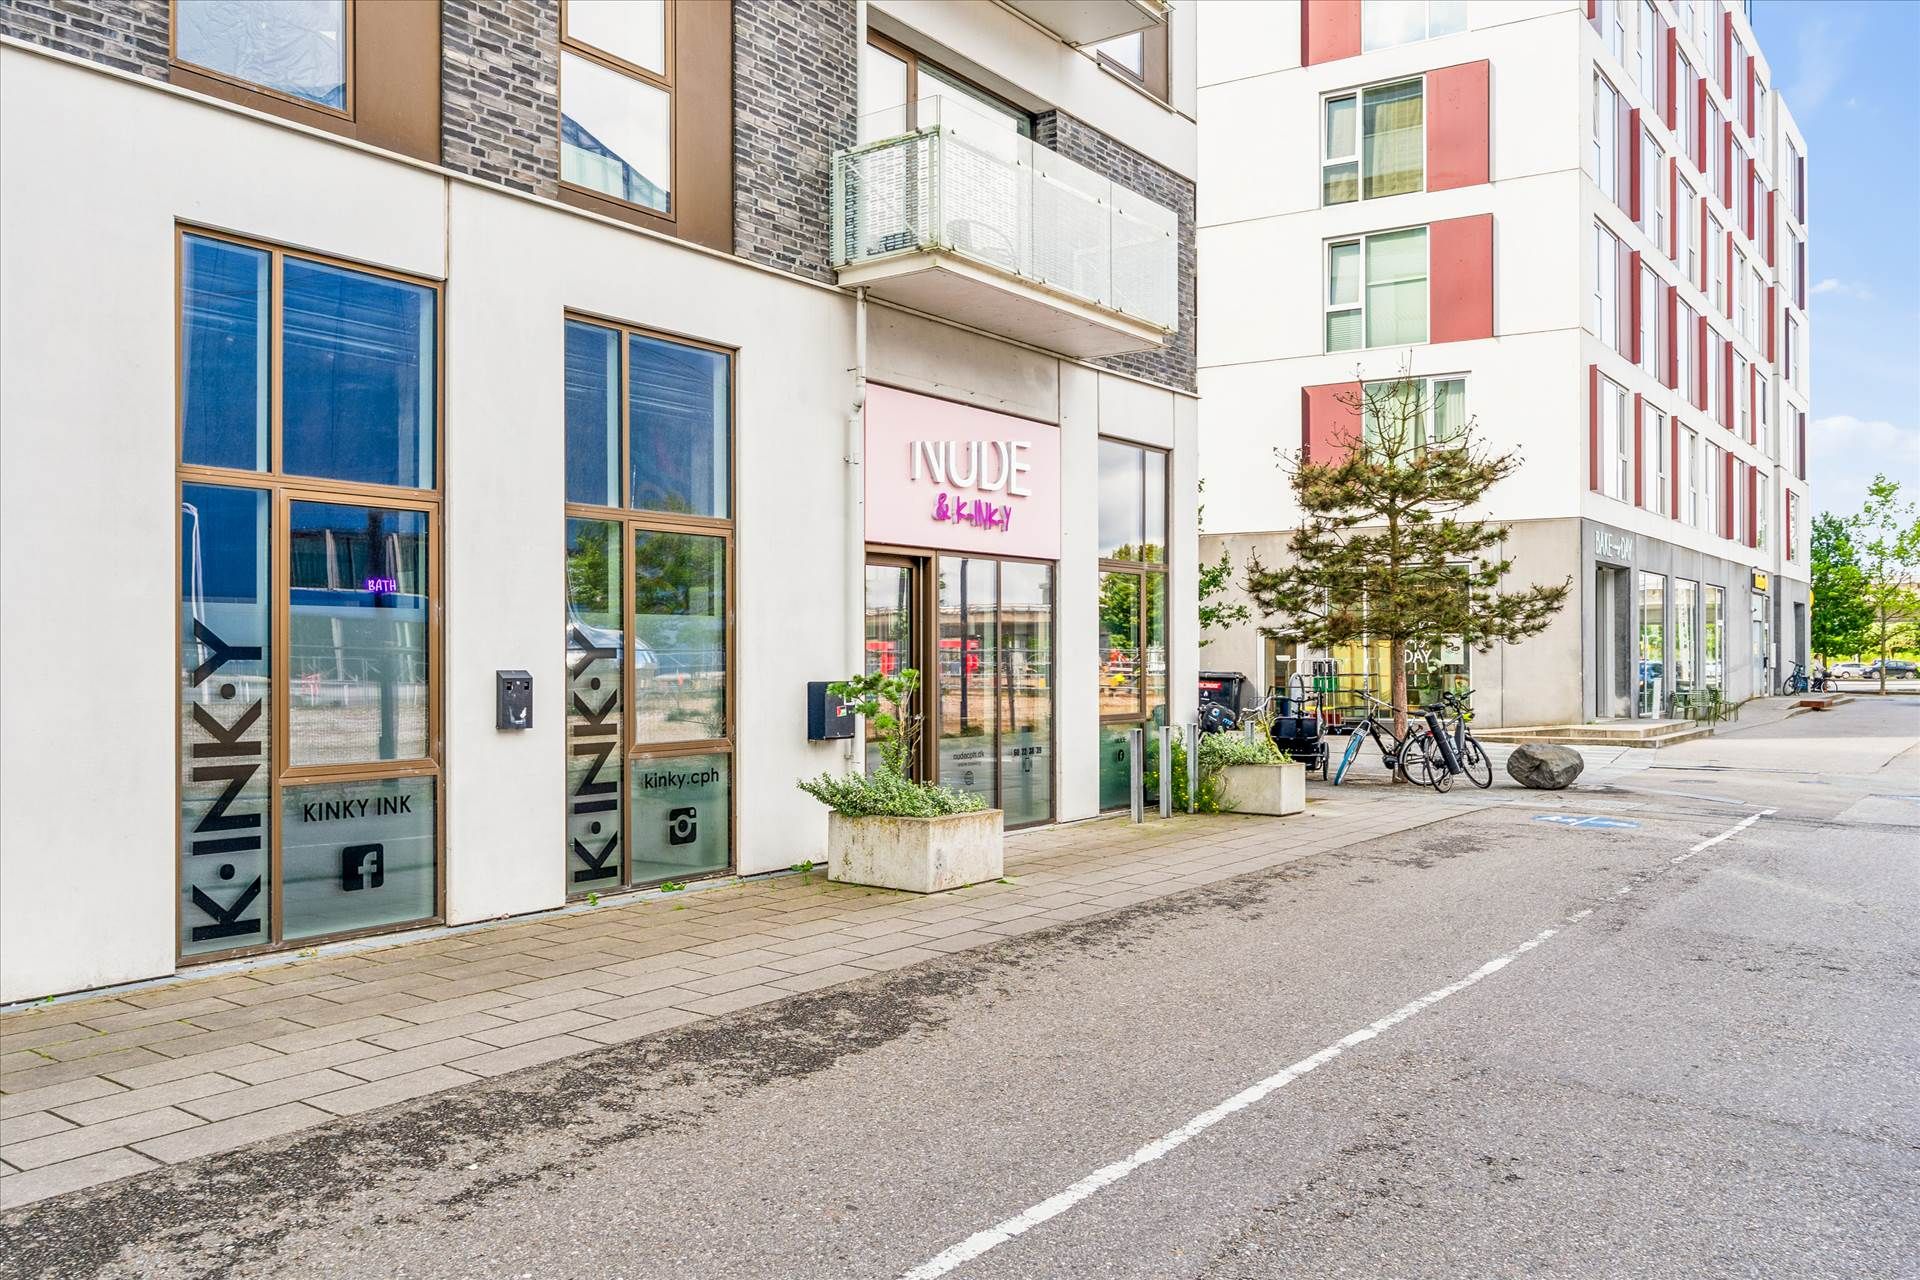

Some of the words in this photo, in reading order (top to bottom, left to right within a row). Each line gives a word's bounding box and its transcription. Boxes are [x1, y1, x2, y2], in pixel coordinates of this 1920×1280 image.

[910, 441, 1032, 497] NUDE
[934, 493, 950, 520] &
[368, 579, 397, 592] BATH
[1404, 649, 1432, 663] DAY
[644, 768, 719, 790] kinky.cph
[303, 798, 369, 822] KINKY
[377, 795, 411, 815] INK
